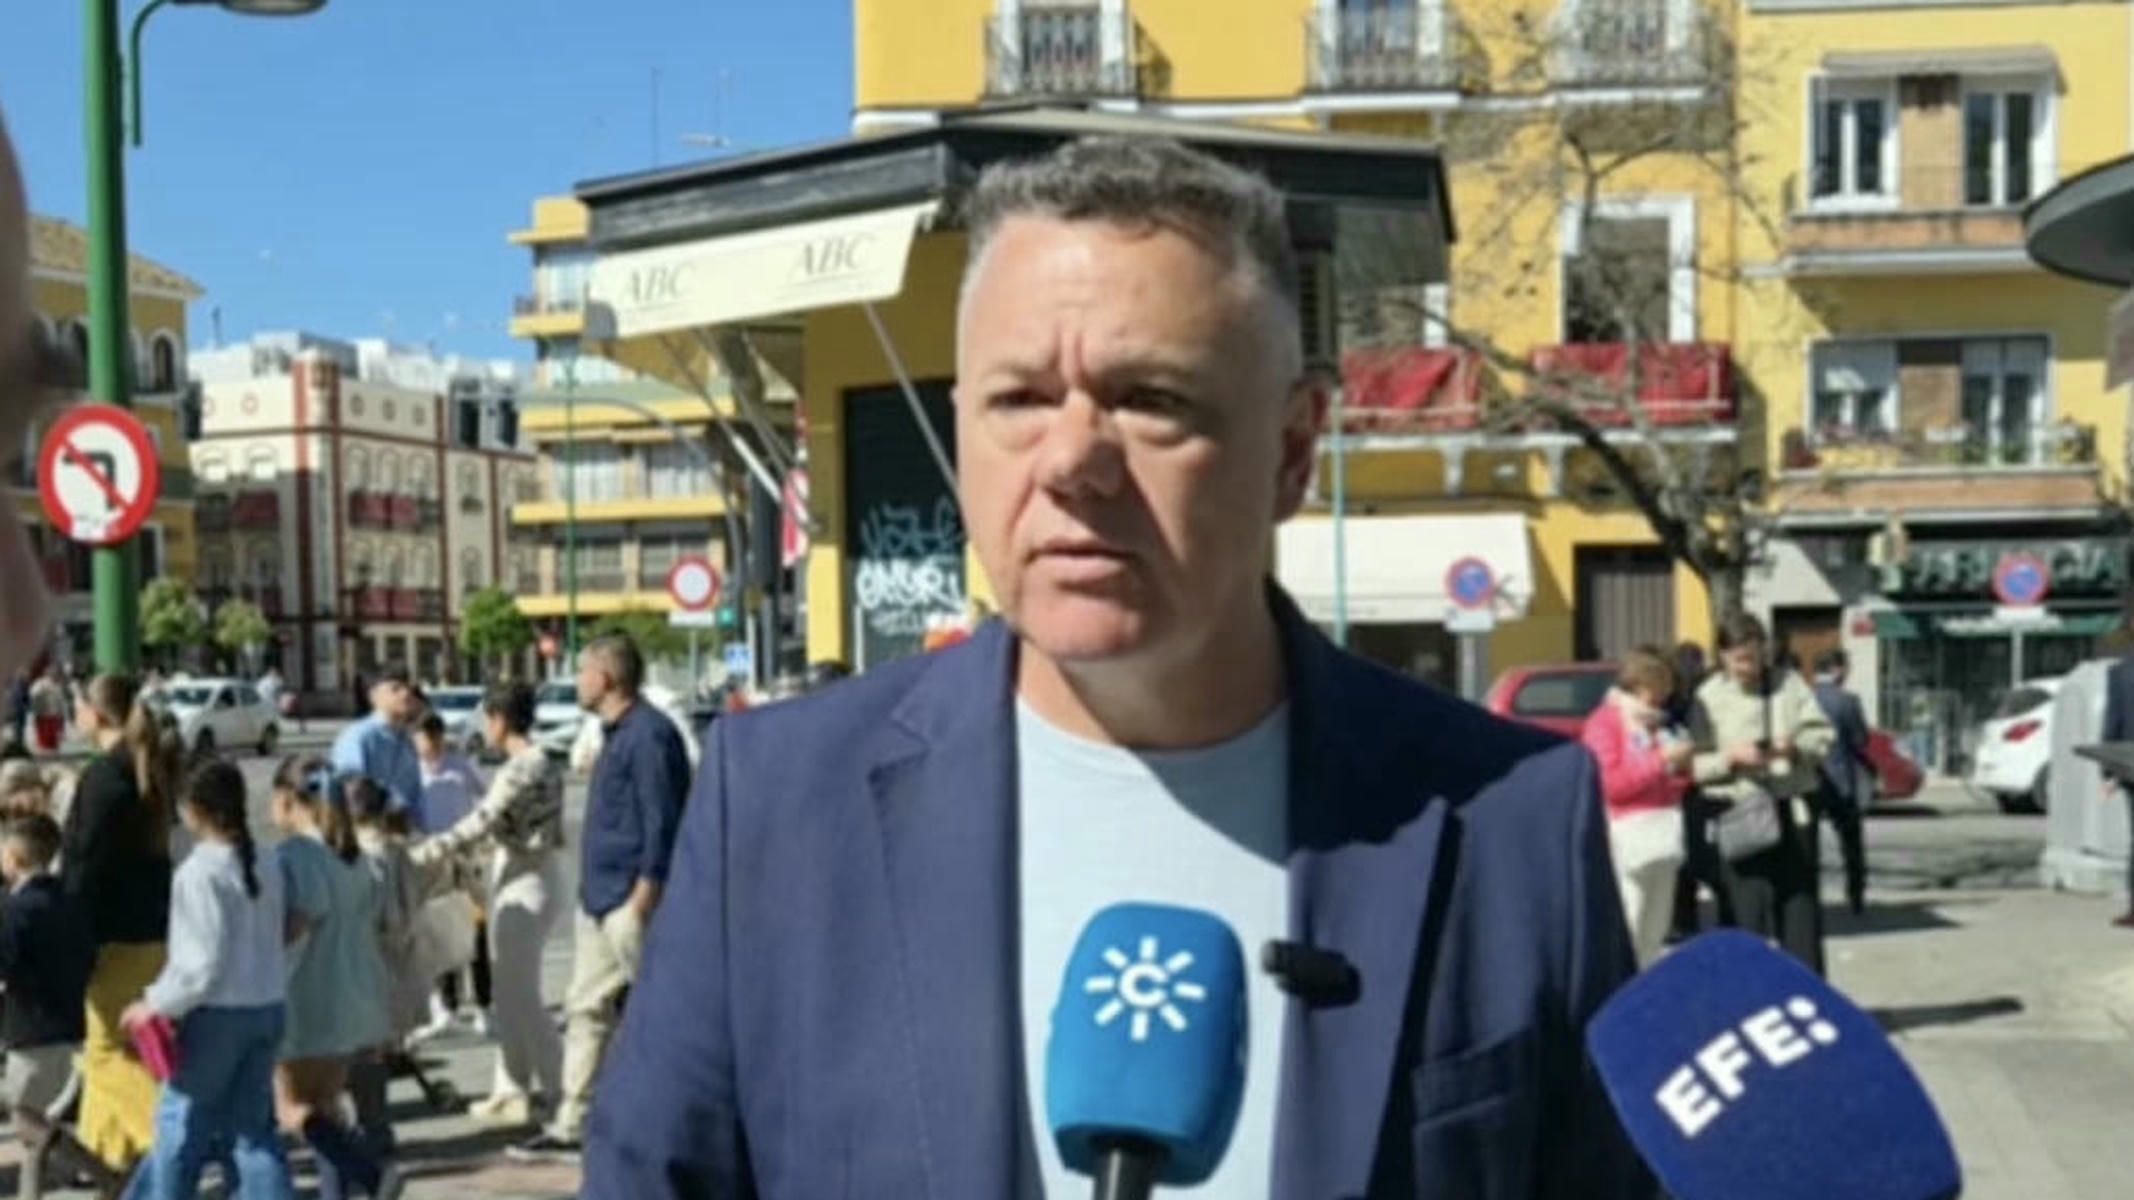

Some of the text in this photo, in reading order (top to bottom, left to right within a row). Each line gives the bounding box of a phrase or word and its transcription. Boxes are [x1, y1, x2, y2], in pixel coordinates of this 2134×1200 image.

[792, 233, 876, 276] ABC
[621, 263, 697, 303] ABC
[1118, 961, 1168, 1008] C
